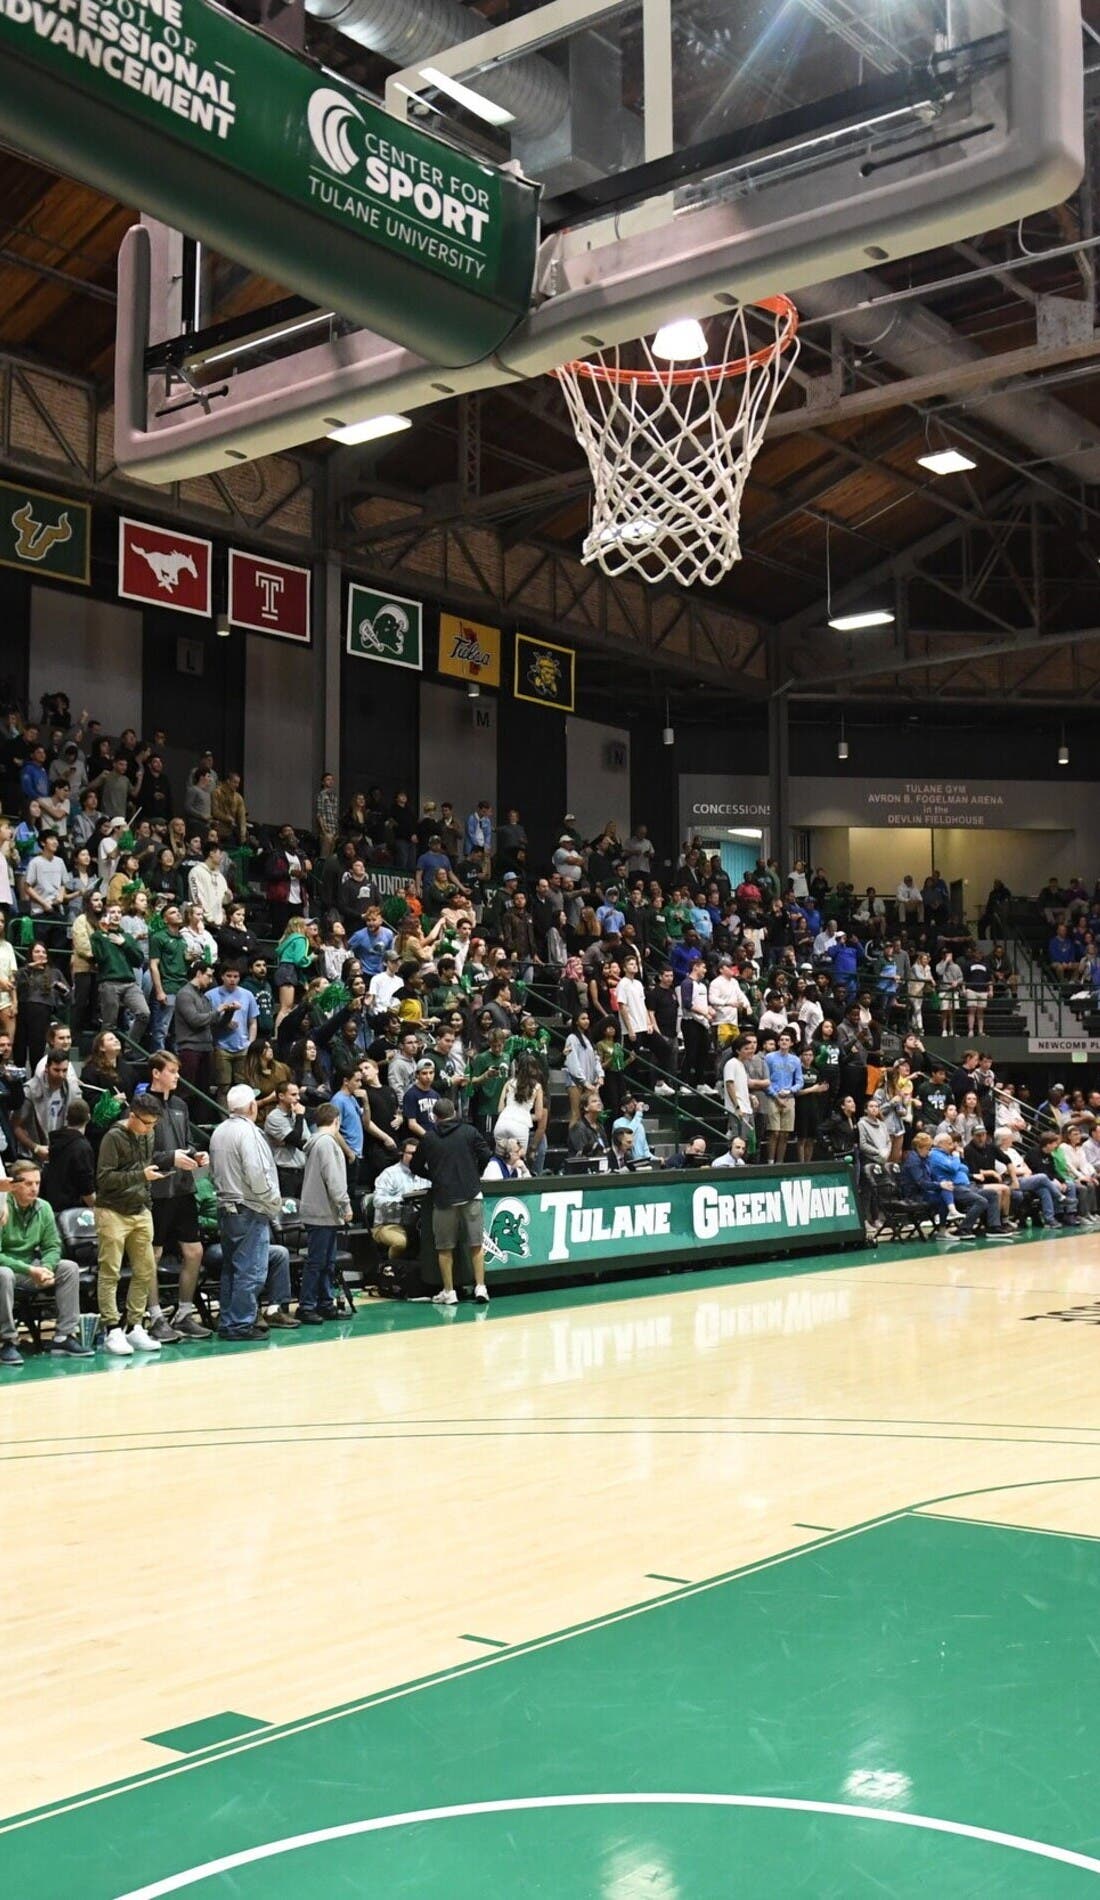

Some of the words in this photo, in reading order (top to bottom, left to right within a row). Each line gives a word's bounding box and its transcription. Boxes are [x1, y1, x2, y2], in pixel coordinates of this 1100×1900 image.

[138, 0, 183, 29] NE
[45, 0, 236, 112] FESSIONAL
[163, 26, 198, 57] OF
[364, 132, 444, 188] CENTER
[450, 176, 489, 210] FOR
[365, 156, 490, 242] SPORT
[308, 175, 381, 229] TULANE
[386, 217, 486, 279] UNIVERSITY
[255, 571, 284, 620] T
[450, 635, 490, 666] Tulsa
[476, 710, 490, 729] M
[868, 794, 901, 804] AVRON
[903, 795, 912, 804] B.
[916, 795, 969, 804] FOGELMAN
[970, 795, 1004, 805] ARENA
[905, 784, 943, 793] TULANE
[945, 785, 966, 794] GYM
[887, 814, 922, 824] DEVLIN
[924, 815, 984, 825] FIELDHOUSE
[934, 805, 949, 814] the
[1038, 1041, 1088, 1050] NEWCOMB
[540, 1190, 671, 1261] TULANE
